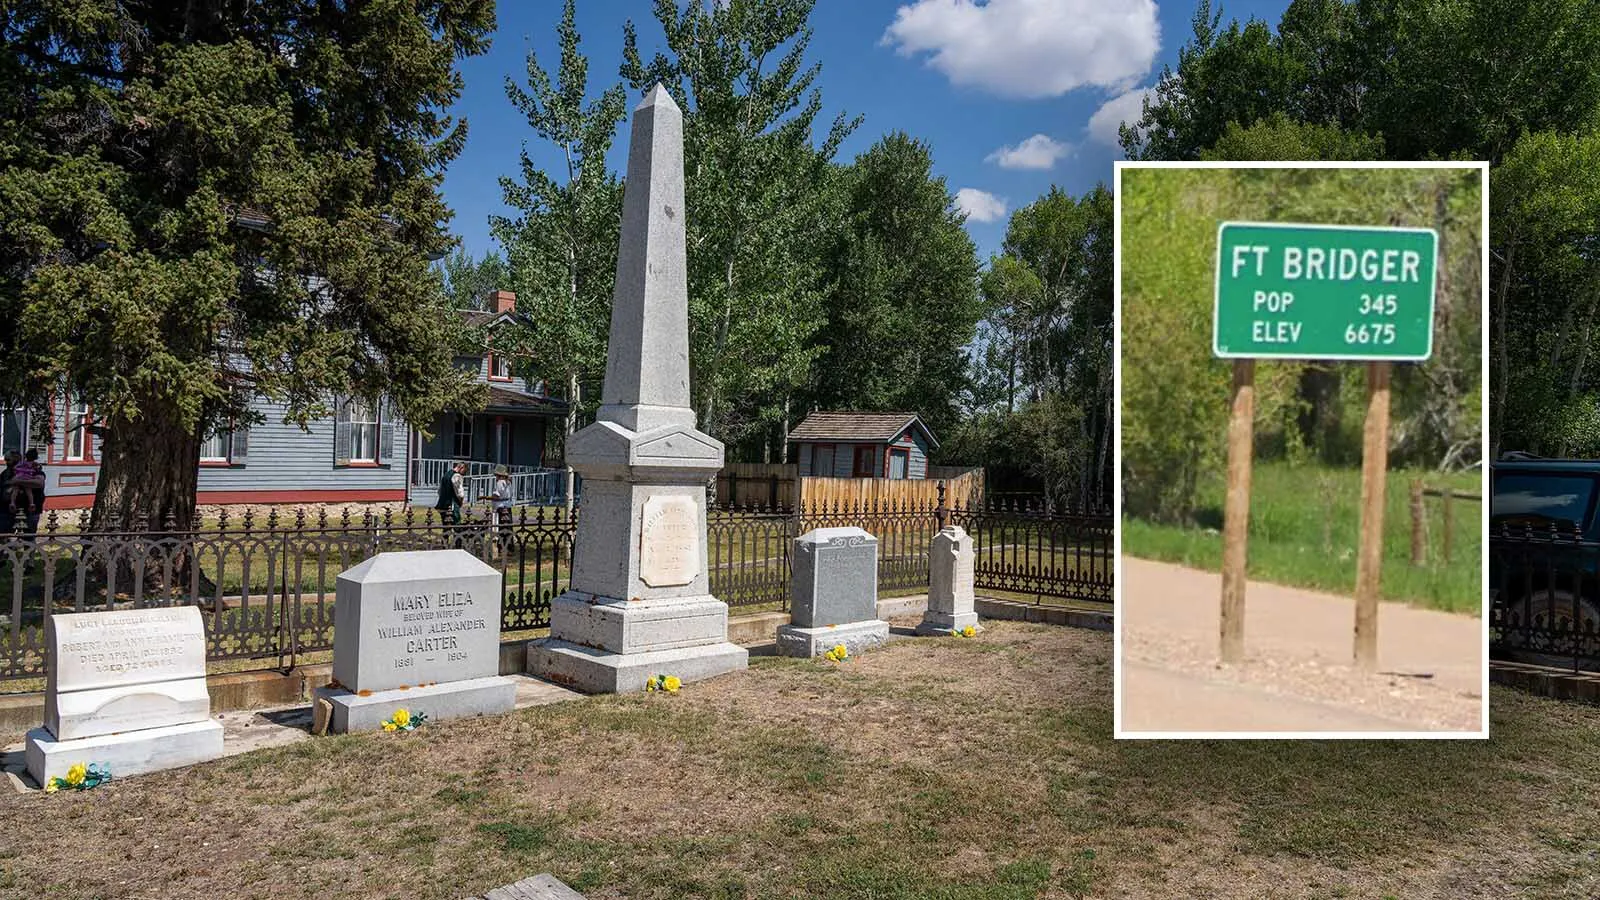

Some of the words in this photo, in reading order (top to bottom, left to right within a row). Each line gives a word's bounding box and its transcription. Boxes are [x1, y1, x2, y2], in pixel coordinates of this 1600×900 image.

[1231, 245, 1270, 278] FT
[1283, 247, 1420, 283] BRIDGER
[1253, 290, 1294, 313] POP
[1358, 294, 1398, 315] 345
[1252, 320, 1302, 343] ELEV
[1344, 323, 1396, 345] 6675
[393, 594, 433, 611] MARY
[438, 591, 473, 607] ELIZA
[377, 624, 423, 639] WILLIAM
[428, 618, 485, 634] ALEXANDER
[406, 636, 458, 653] CARTER
